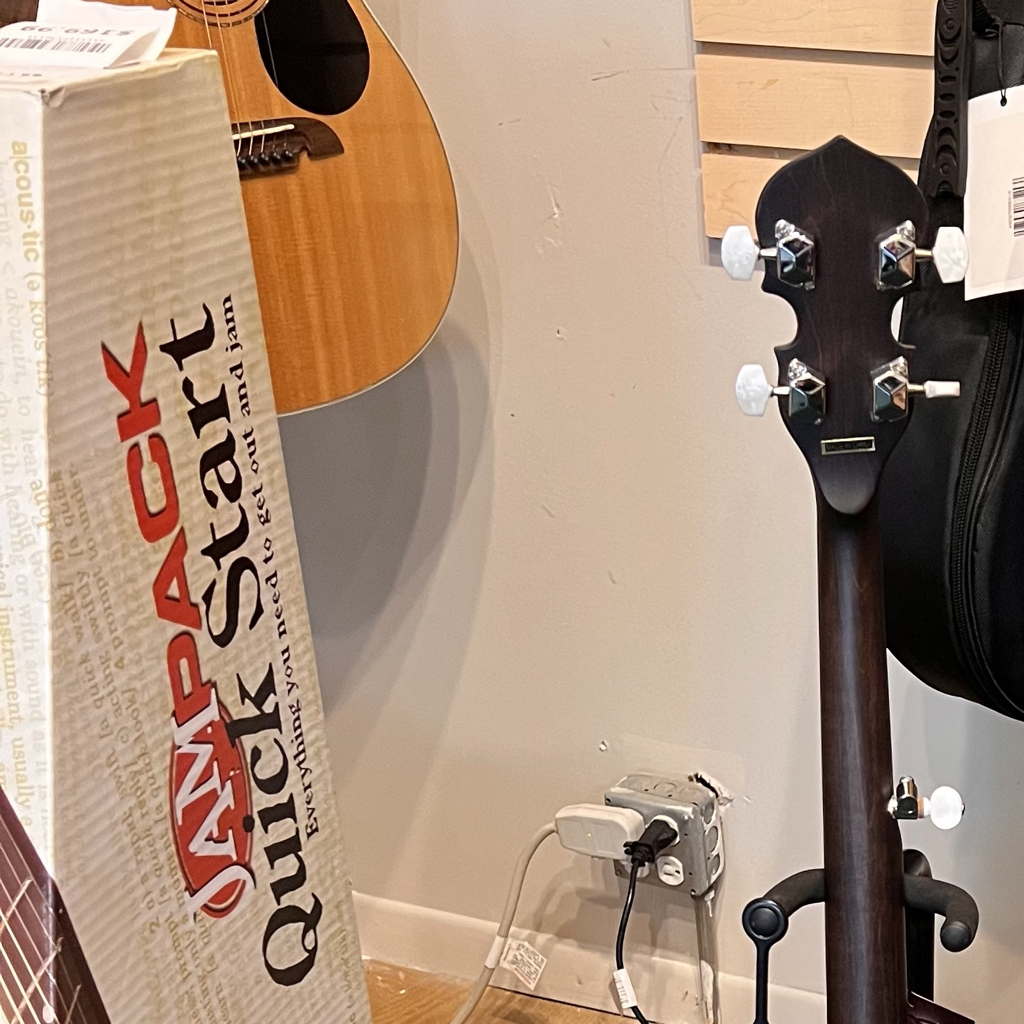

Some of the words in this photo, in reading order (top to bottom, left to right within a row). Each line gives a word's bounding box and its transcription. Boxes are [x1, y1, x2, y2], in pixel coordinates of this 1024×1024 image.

[222, 293, 243, 353] jam
[229, 360, 252, 417] and
[159, 302, 265, 649] Start
[242, 427, 260, 474] out
[252, 482, 271, 527] get
[263, 536, 275, 565] to
[265, 568, 288, 640] need
[280, 645, 299, 696] you
[288, 700, 319, 841] Everything
[225, 662, 323, 987] Quick
